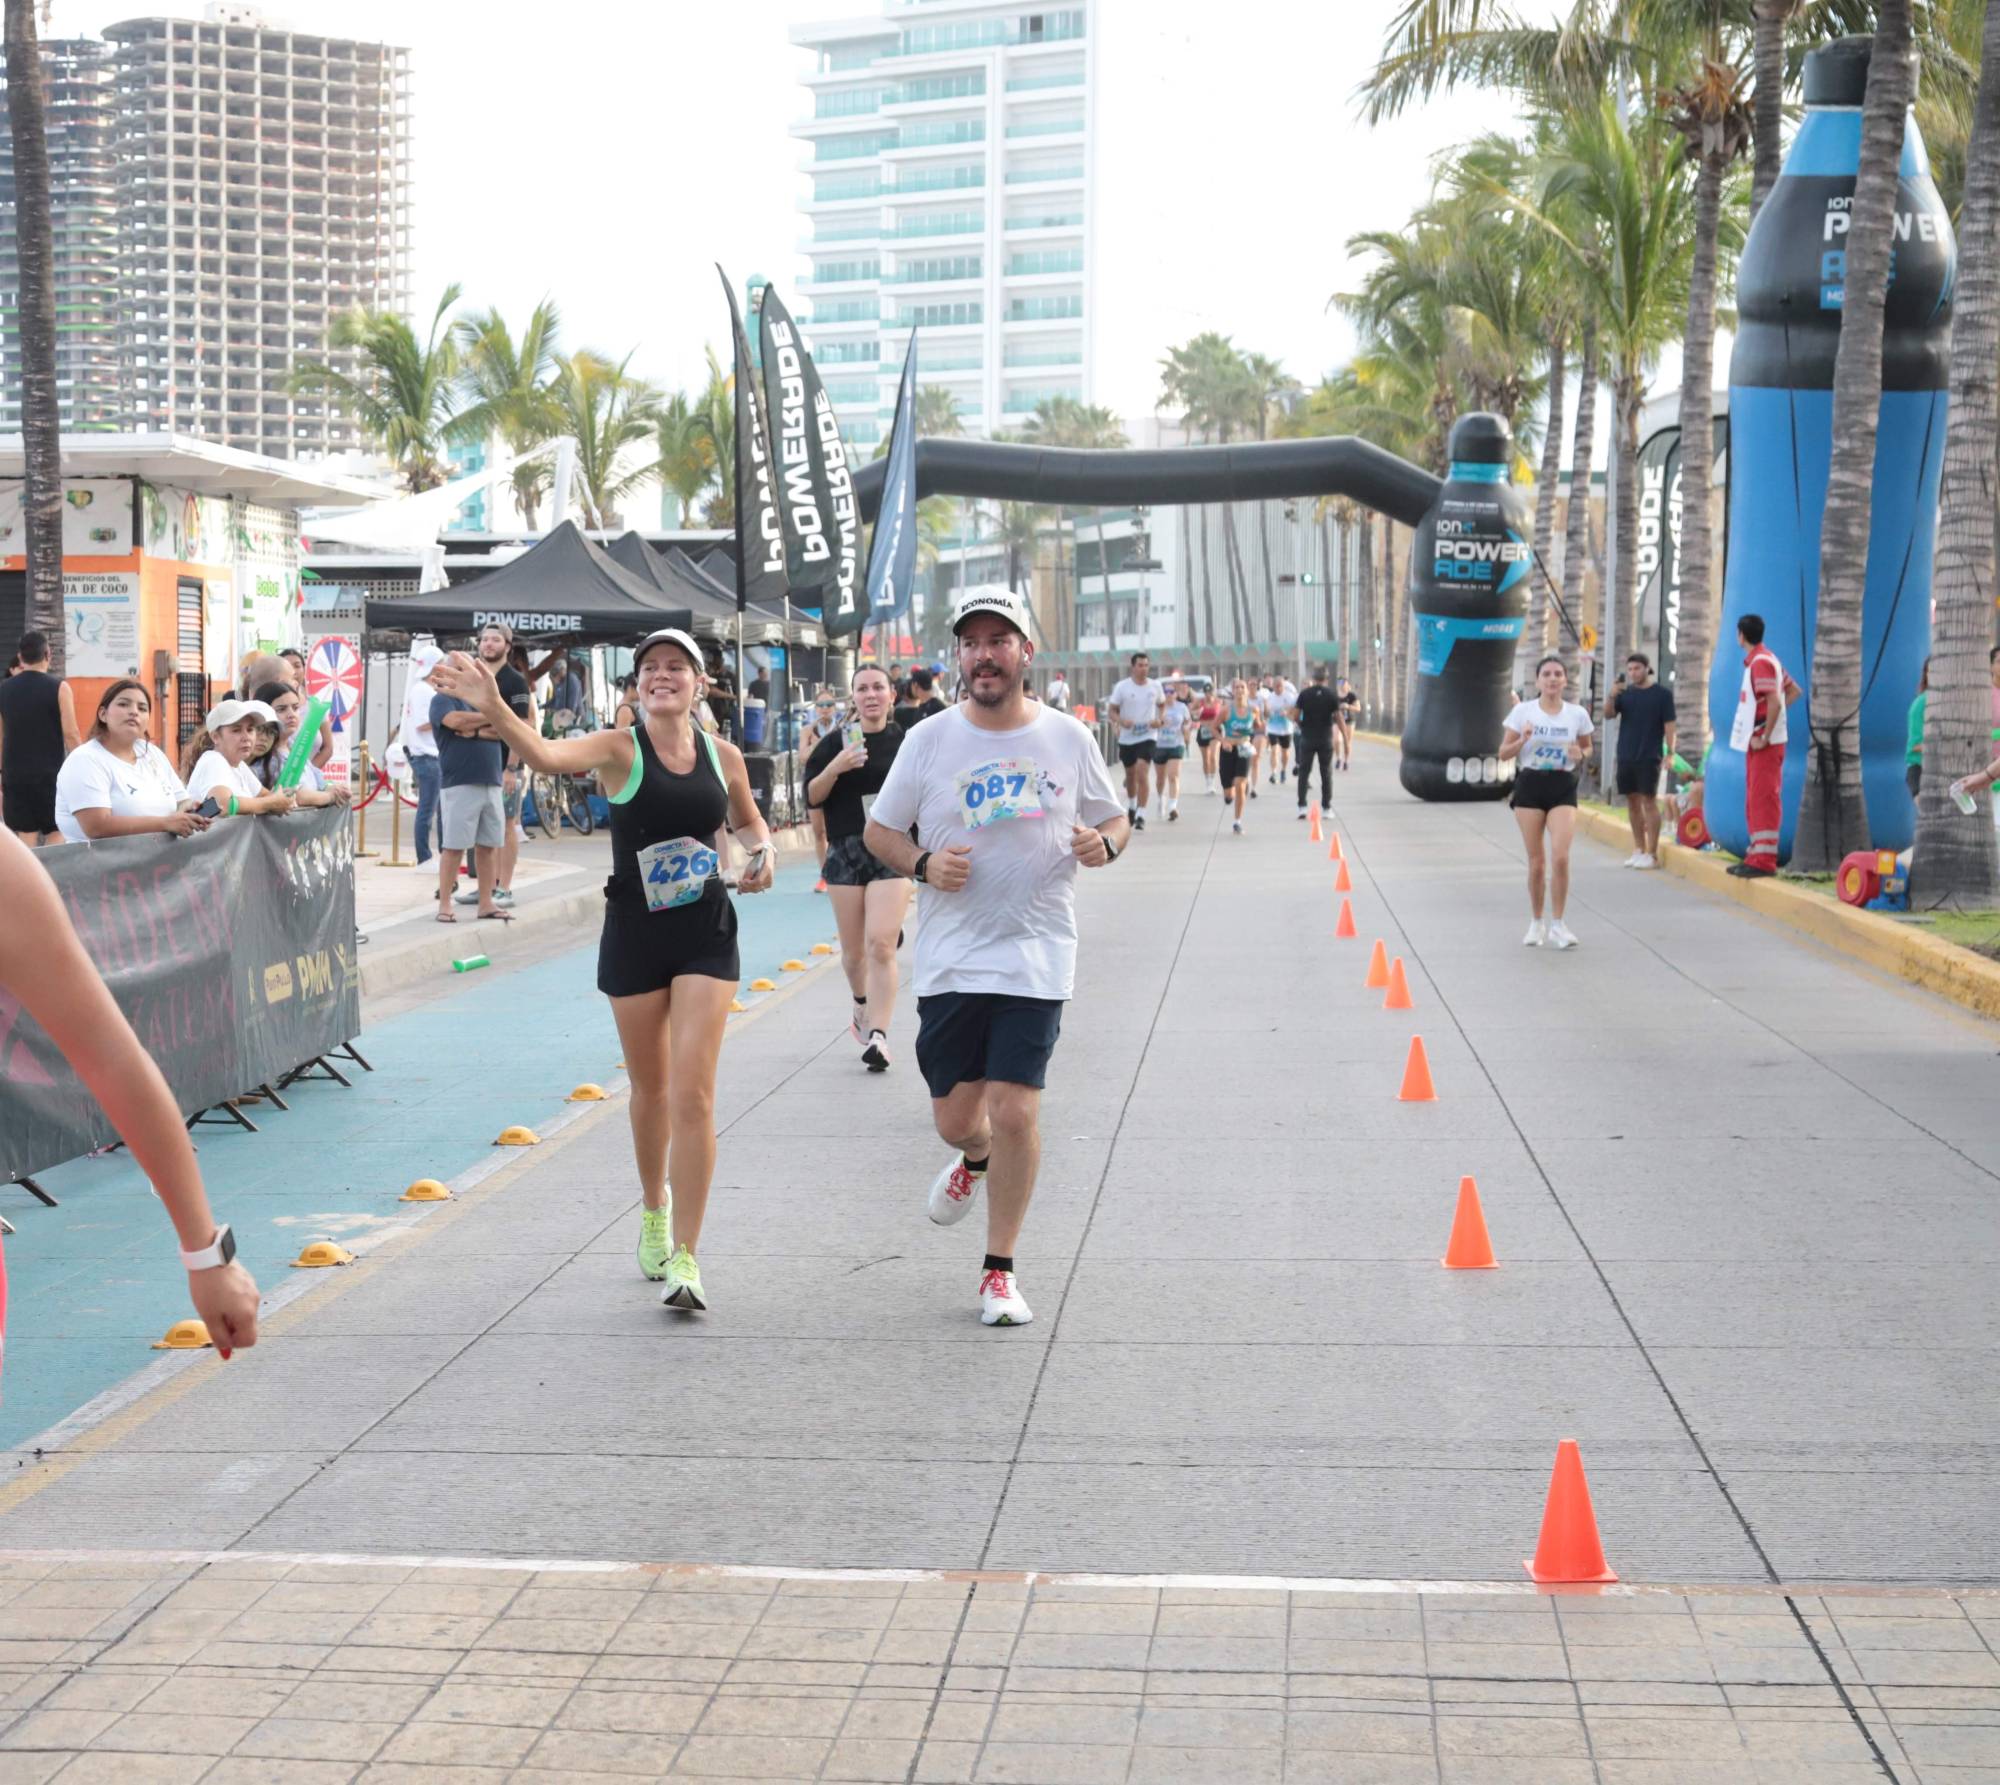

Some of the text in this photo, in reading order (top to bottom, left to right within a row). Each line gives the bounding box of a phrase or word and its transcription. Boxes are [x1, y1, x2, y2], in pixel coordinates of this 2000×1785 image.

[1823, 211, 1949, 242] PWE
[768, 319, 831, 563] POWERADE
[813, 387, 856, 616] POWERADE
[1434, 539, 1530, 562] POWER
[1434, 559, 1493, 581] ADE
[82, 584, 97, 594] DE
[101, 583, 129, 594] COCO
[961, 597, 1014, 613] ECONOMÍA
[472, 611, 583, 631] POWERADE
[1535, 747, 1562, 760] 473
[965, 774, 1027, 809] 087
[647, 850, 711, 885] 426
